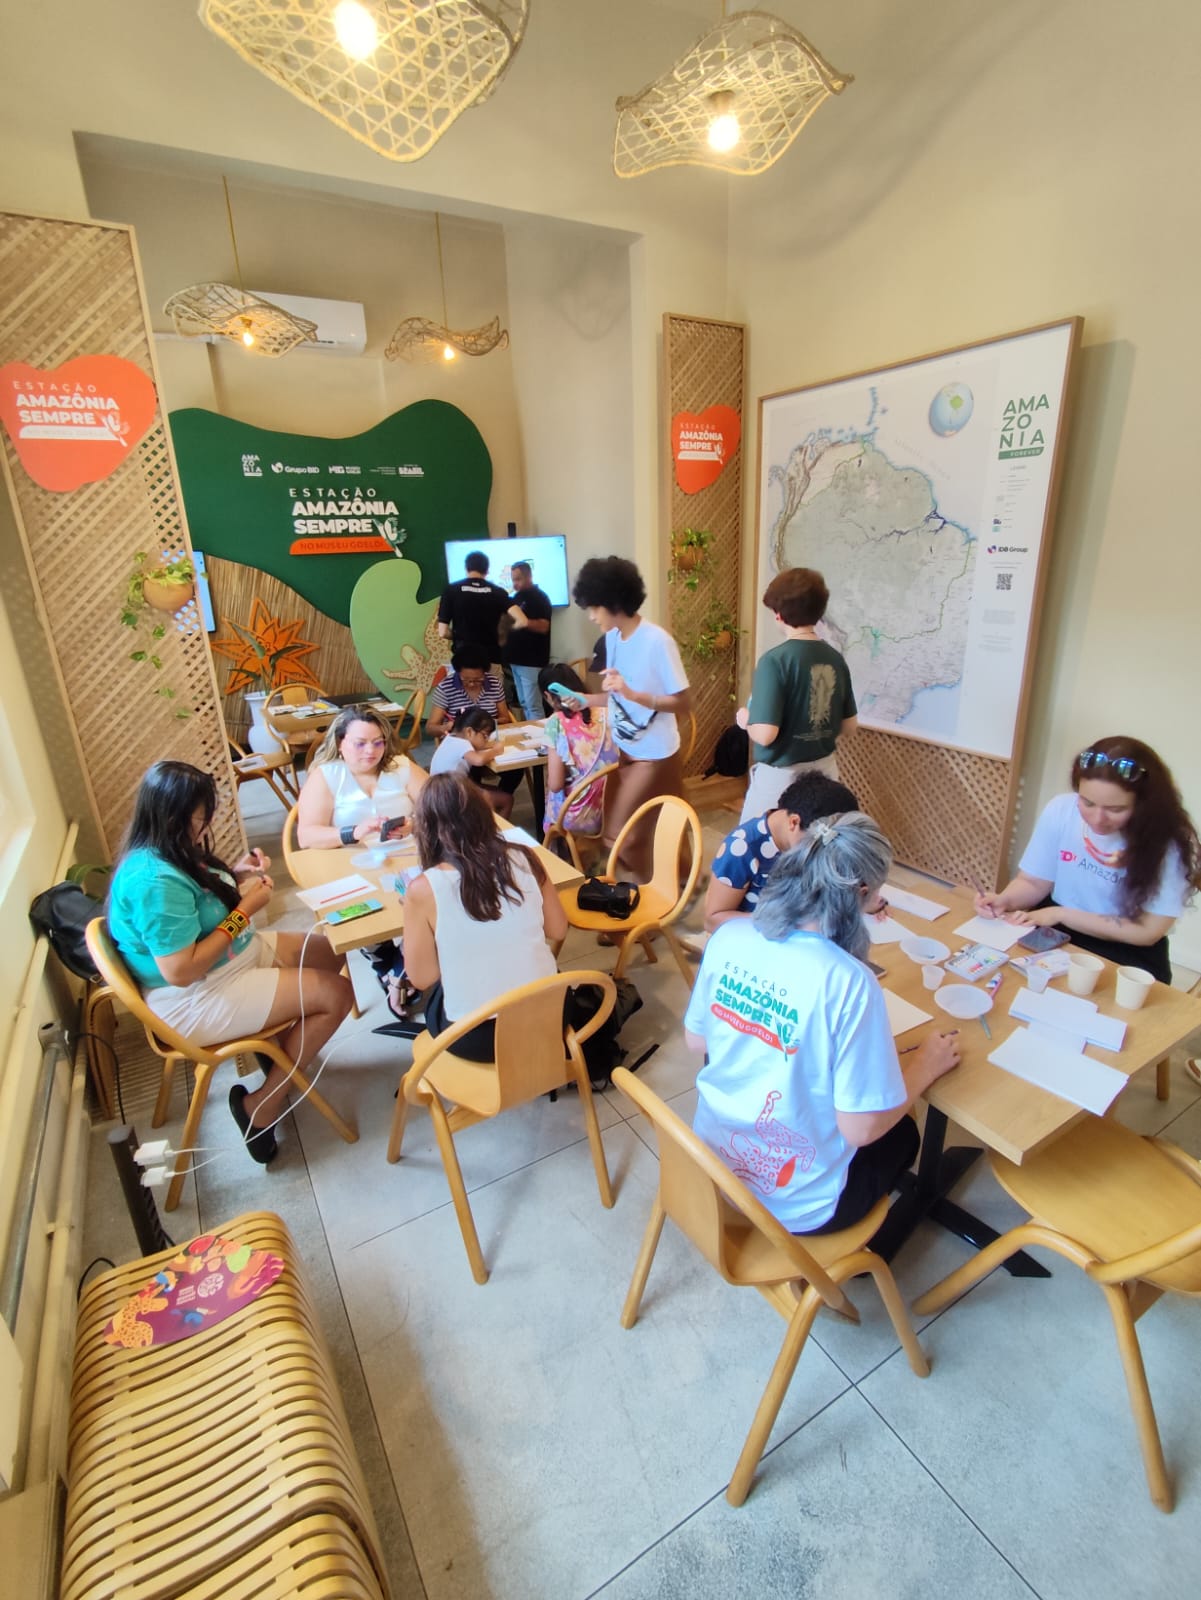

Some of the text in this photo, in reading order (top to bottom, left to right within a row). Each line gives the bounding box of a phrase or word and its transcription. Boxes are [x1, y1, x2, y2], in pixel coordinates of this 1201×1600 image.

[12, 380, 97, 393] ESTAÇÃO
[16, 393, 120, 410] AMAZÔNIA
[1003, 394, 1049, 416] AMA
[19, 410, 96, 425] SEMPRE
[1001, 414, 1032, 432] ZO
[680, 430, 723, 441] AMAZÔNIA
[1000, 429, 1044, 449] NIA
[680, 441, 712, 450] SEMPRE
[289, 487, 377, 499] ESTAÇÃO
[292, 497, 399, 516] AMAZÔNIA
[293, 518, 373, 534] SEMPRE
[724, 961, 787, 997] ESTAÇÃO
[715, 988, 773, 1027] SEMPRE
[719, 974, 798, 1024] AMAZÔNIA
